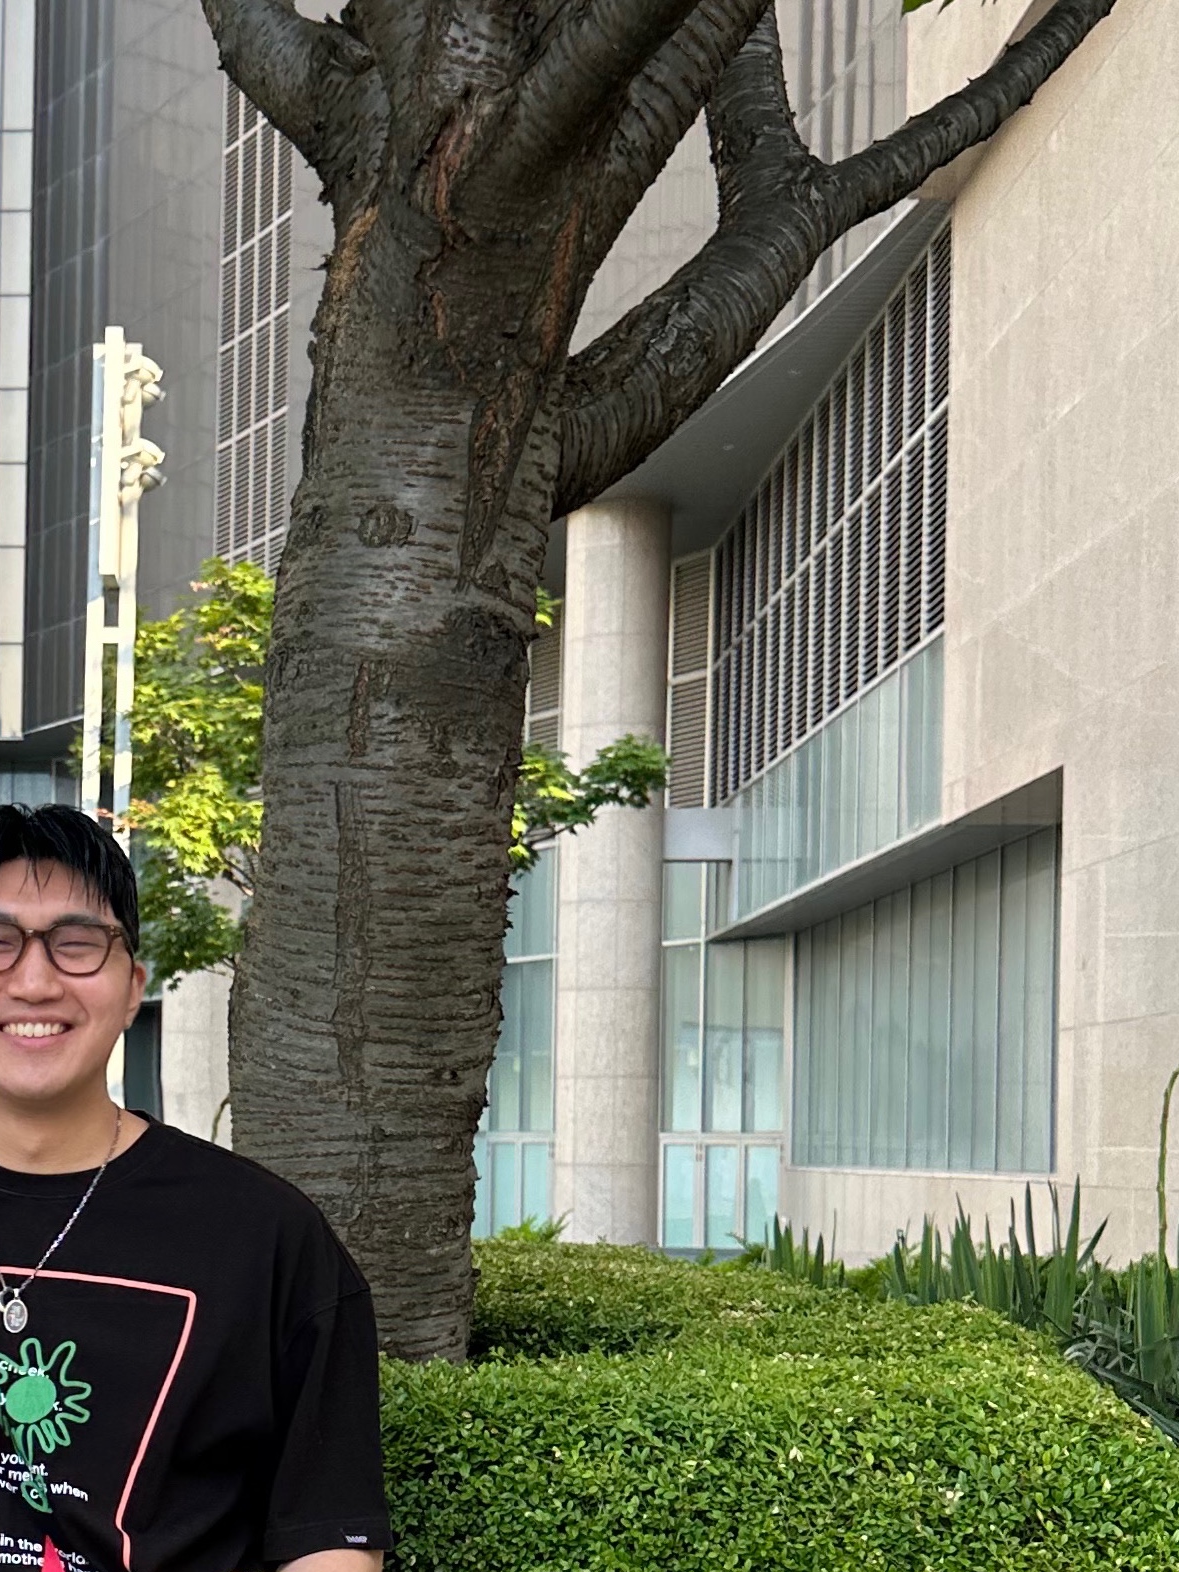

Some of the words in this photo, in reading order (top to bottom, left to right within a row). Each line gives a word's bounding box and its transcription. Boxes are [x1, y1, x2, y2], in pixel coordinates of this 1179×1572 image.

[50, 1481, 89, 1502] when
[0, 1532, 15, 1548] in
[17, 1538, 43, 1553] the
